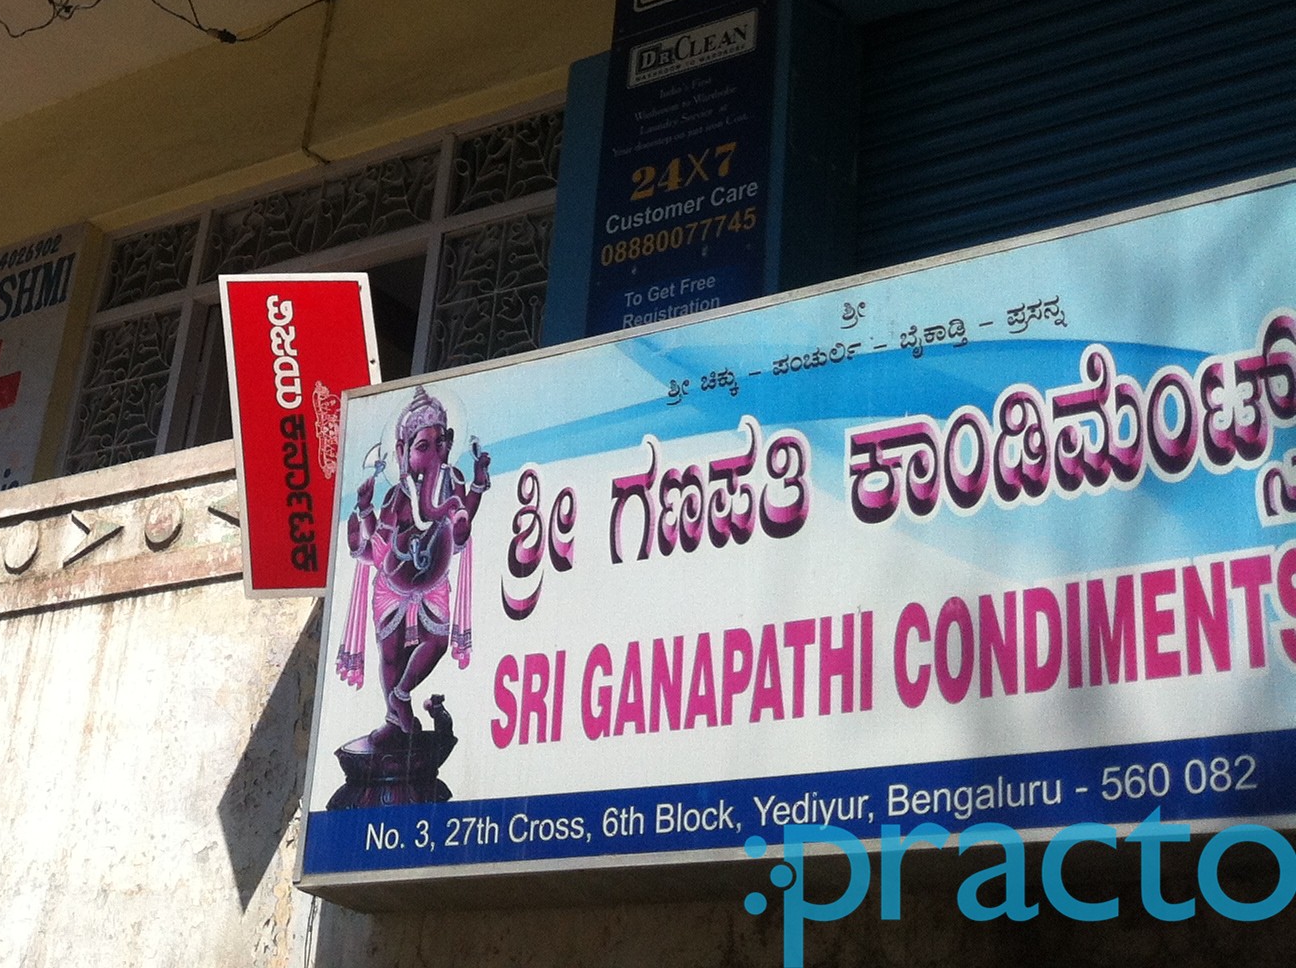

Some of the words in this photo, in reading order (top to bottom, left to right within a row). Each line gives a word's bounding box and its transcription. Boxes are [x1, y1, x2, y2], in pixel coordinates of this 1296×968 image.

[601, 205, 757, 267] 08880077745
[605, 195, 705, 234] Customer
[710, 181, 759, 207] Care
[622, 296, 721, 329] Registration
[624, 291, 643, 308] To
[647, 284, 676, 302] Get
[679, 275, 717, 296] Free
[840, 301, 867, 329] ಶ್ರೀ
[266, 295, 303, 410] ವಿಜಯ
[666, 377, 690, 406] ಶ್ರೀ
[280, 414, 319, 573] ಕರ್ನಾಟಕ
[501, 468, 577, 621] ಶ್ರೀ
[609, 421, 810, 565] ಗಣಪತಿ
[491, 650, 566, 749] SRI
[581, 610, 873, 741] GANAPATHI
[365, 823, 405, 851] No.
[414, 820, 436, 852] 3,
[444, 815, 499, 847] 27th
[509, 812, 592, 844] Cross,
[602, 806, 644, 838] 6th
[656, 799, 742, 835] Block,
[753, 791, 874, 831] Yediyur,
[887, 776, 1063, 821] Bengaluru
[1101, 763, 1171, 802] 560
[1184, 755, 1258, 793] 082
